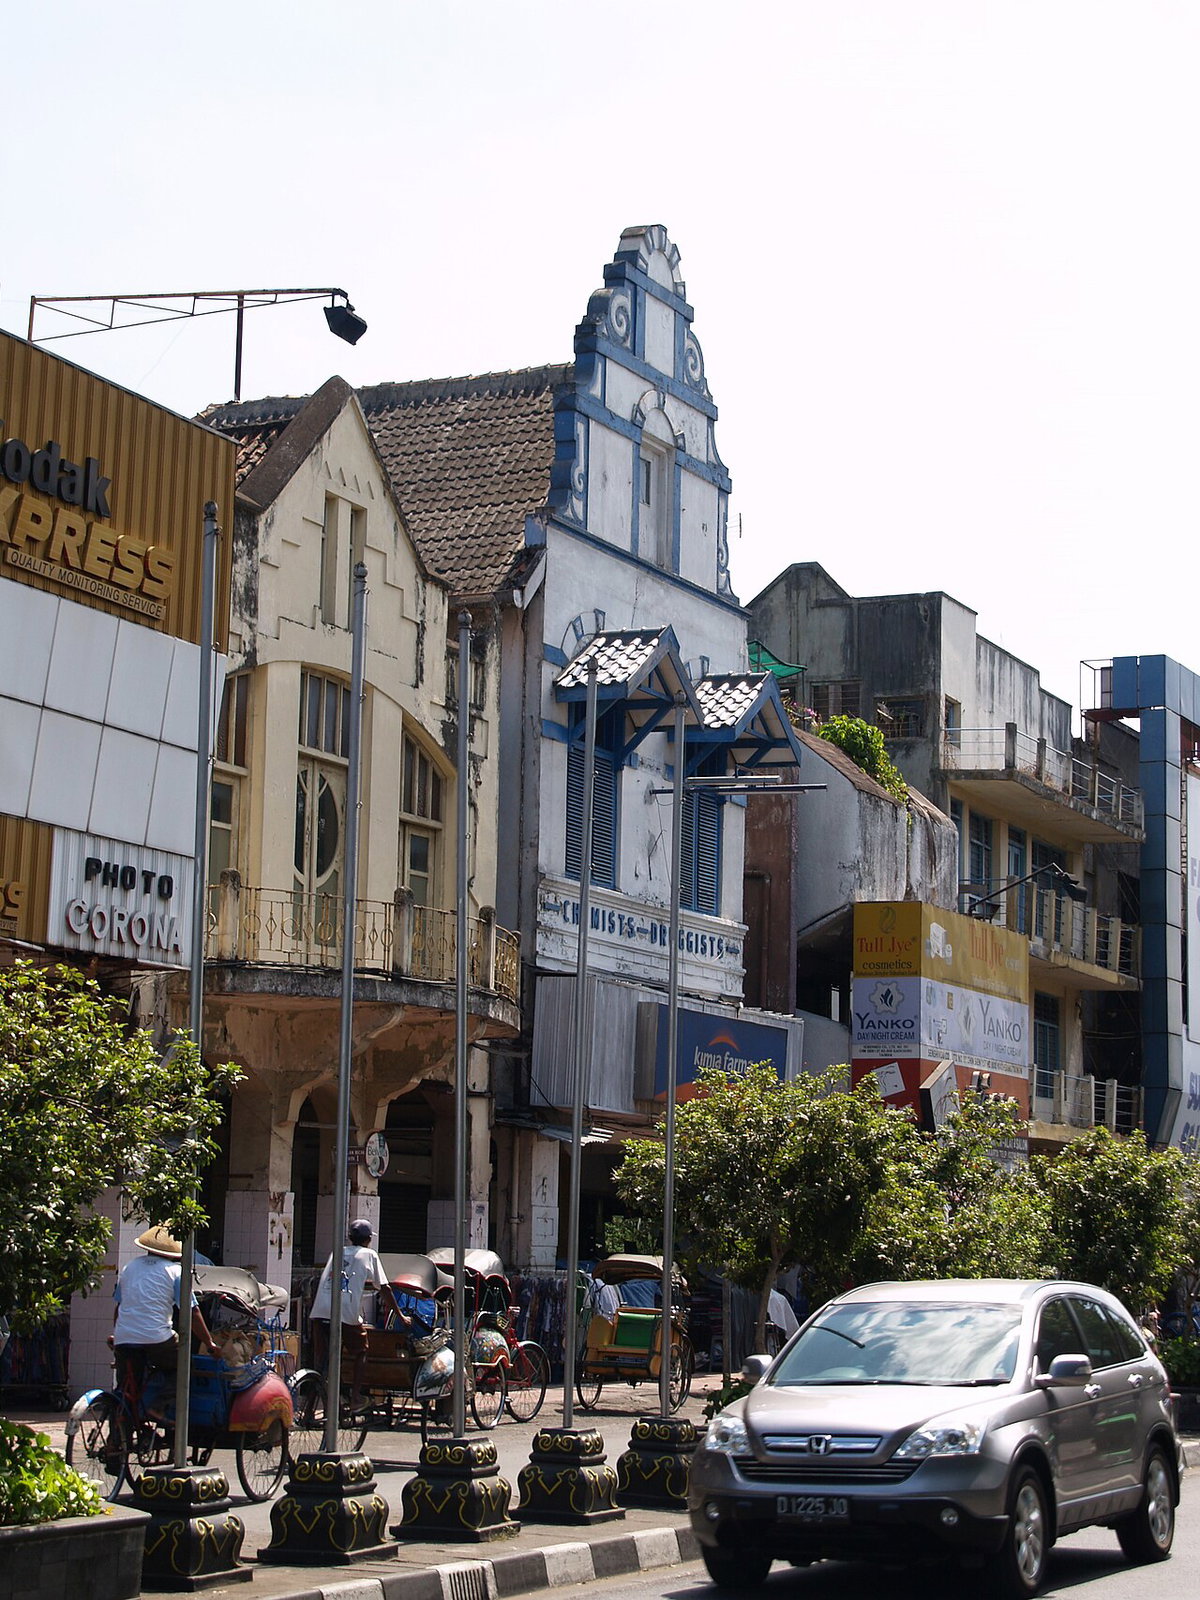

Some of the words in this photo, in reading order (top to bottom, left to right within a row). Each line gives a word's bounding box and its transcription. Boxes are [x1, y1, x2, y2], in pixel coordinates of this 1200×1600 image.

[0, 438, 112, 519] odak
[10, 550, 55, 577] QUALITY
[57, 567, 120, 602] MONITORING
[121, 591, 163, 618] SERVICE
[85, 856, 174, 900] PHOTO
[65, 898, 183, 953] CORONA
[862, 959, 913, 970] cosmetics
[855, 1012, 915, 1030] YANKO
[890, 1031, 915, 1040] CREAM
[979, 998, 1022, 1043] YANKO
[791, 1496, 825, 1514] 1225
